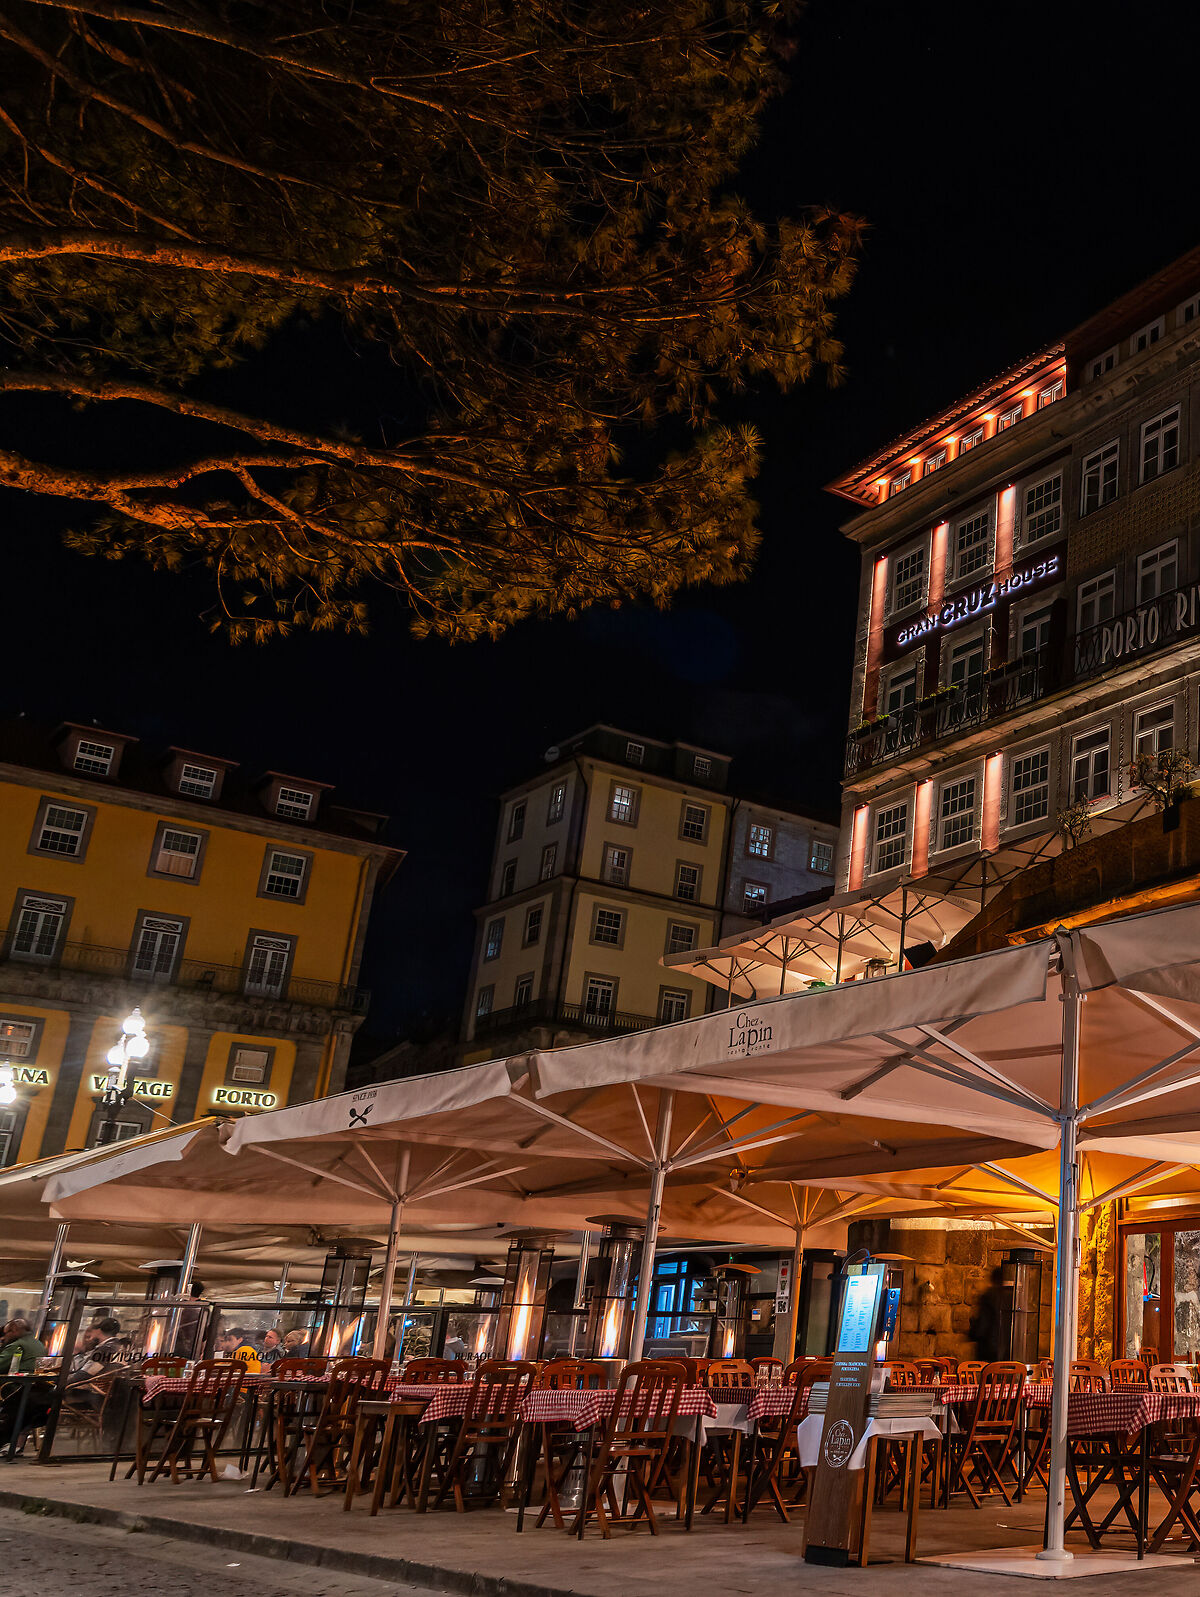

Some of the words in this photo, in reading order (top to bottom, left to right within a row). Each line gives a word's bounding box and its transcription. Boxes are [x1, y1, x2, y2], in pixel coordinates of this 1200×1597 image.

[897, 615, 936, 645] GRAN
[940, 584, 996, 625] CRUZ
[998, 556, 1058, 594] HOUSE
[1102, 605, 1160, 664] PORTO
[736, 1012, 759, 1029] Chez
[728, 1022, 772, 1055] Lapin
[10, 1067, 49, 1085] INA
[93, 1075, 174, 1097] VAGE
[214, 1088, 277, 1108] PORTO
